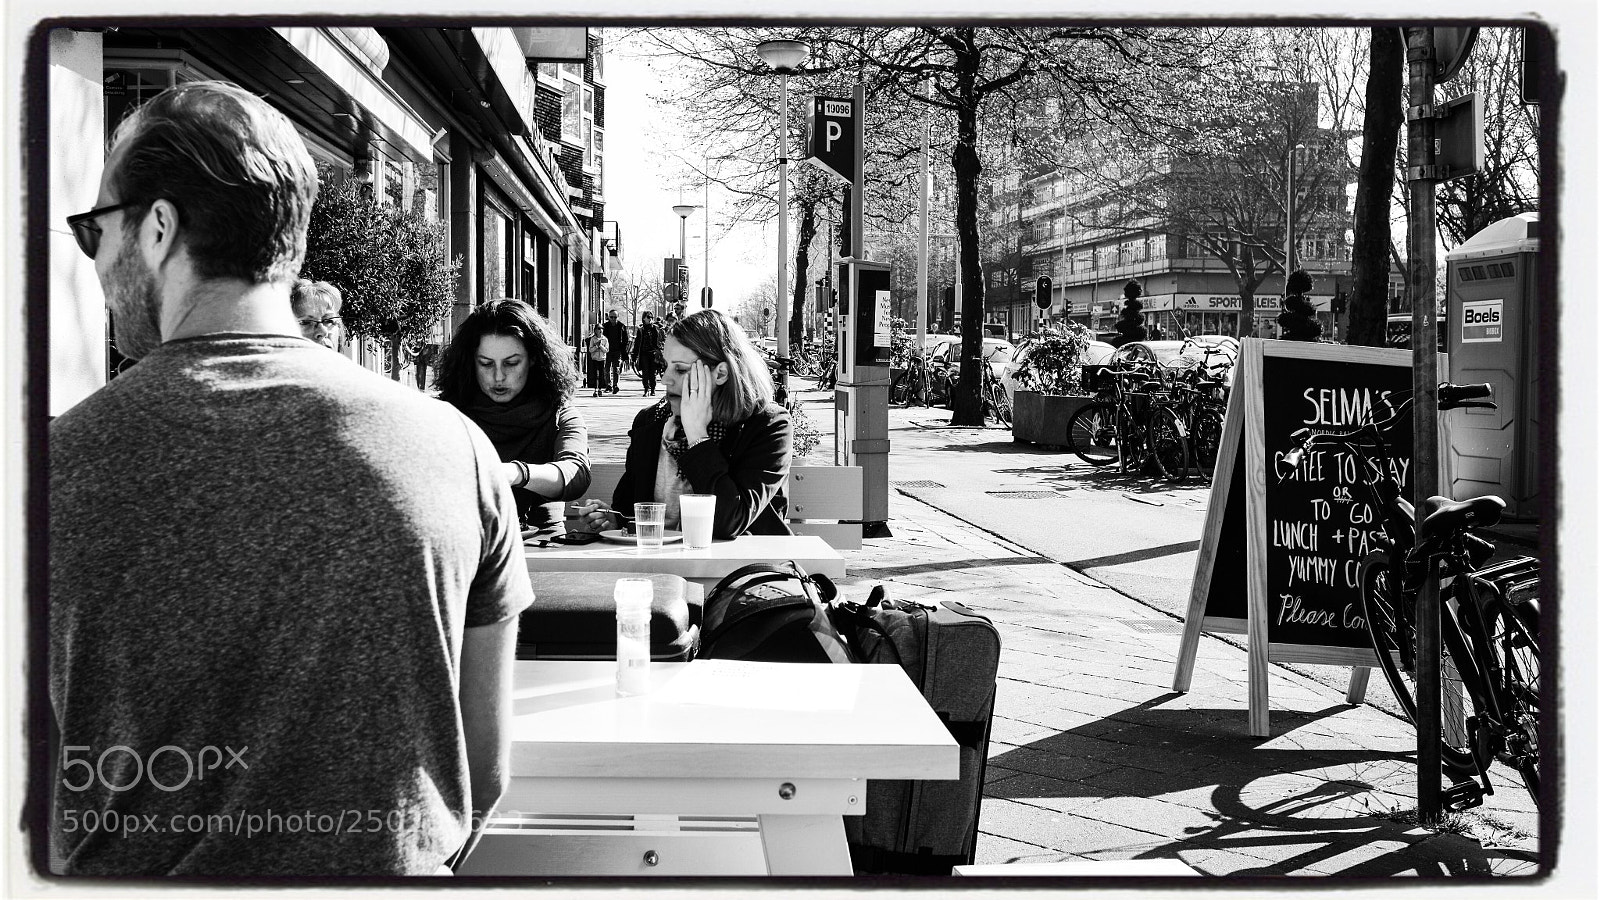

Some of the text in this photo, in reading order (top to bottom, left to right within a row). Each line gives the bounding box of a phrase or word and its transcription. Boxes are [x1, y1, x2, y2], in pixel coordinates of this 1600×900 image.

[826, 120, 842, 153] P
[1465, 307, 1500, 324] Boels
[1303, 387, 1396, 426] SELMA'S
[1333, 452, 1356, 485] TO
[1333, 486, 1353, 499] OR
[1310, 499, 1373, 524] TO GO
[1273, 519, 1318, 552] LUNCH
[1288, 555, 1338, 588] YUMMY
[1277, 593, 1338, 627] Please
